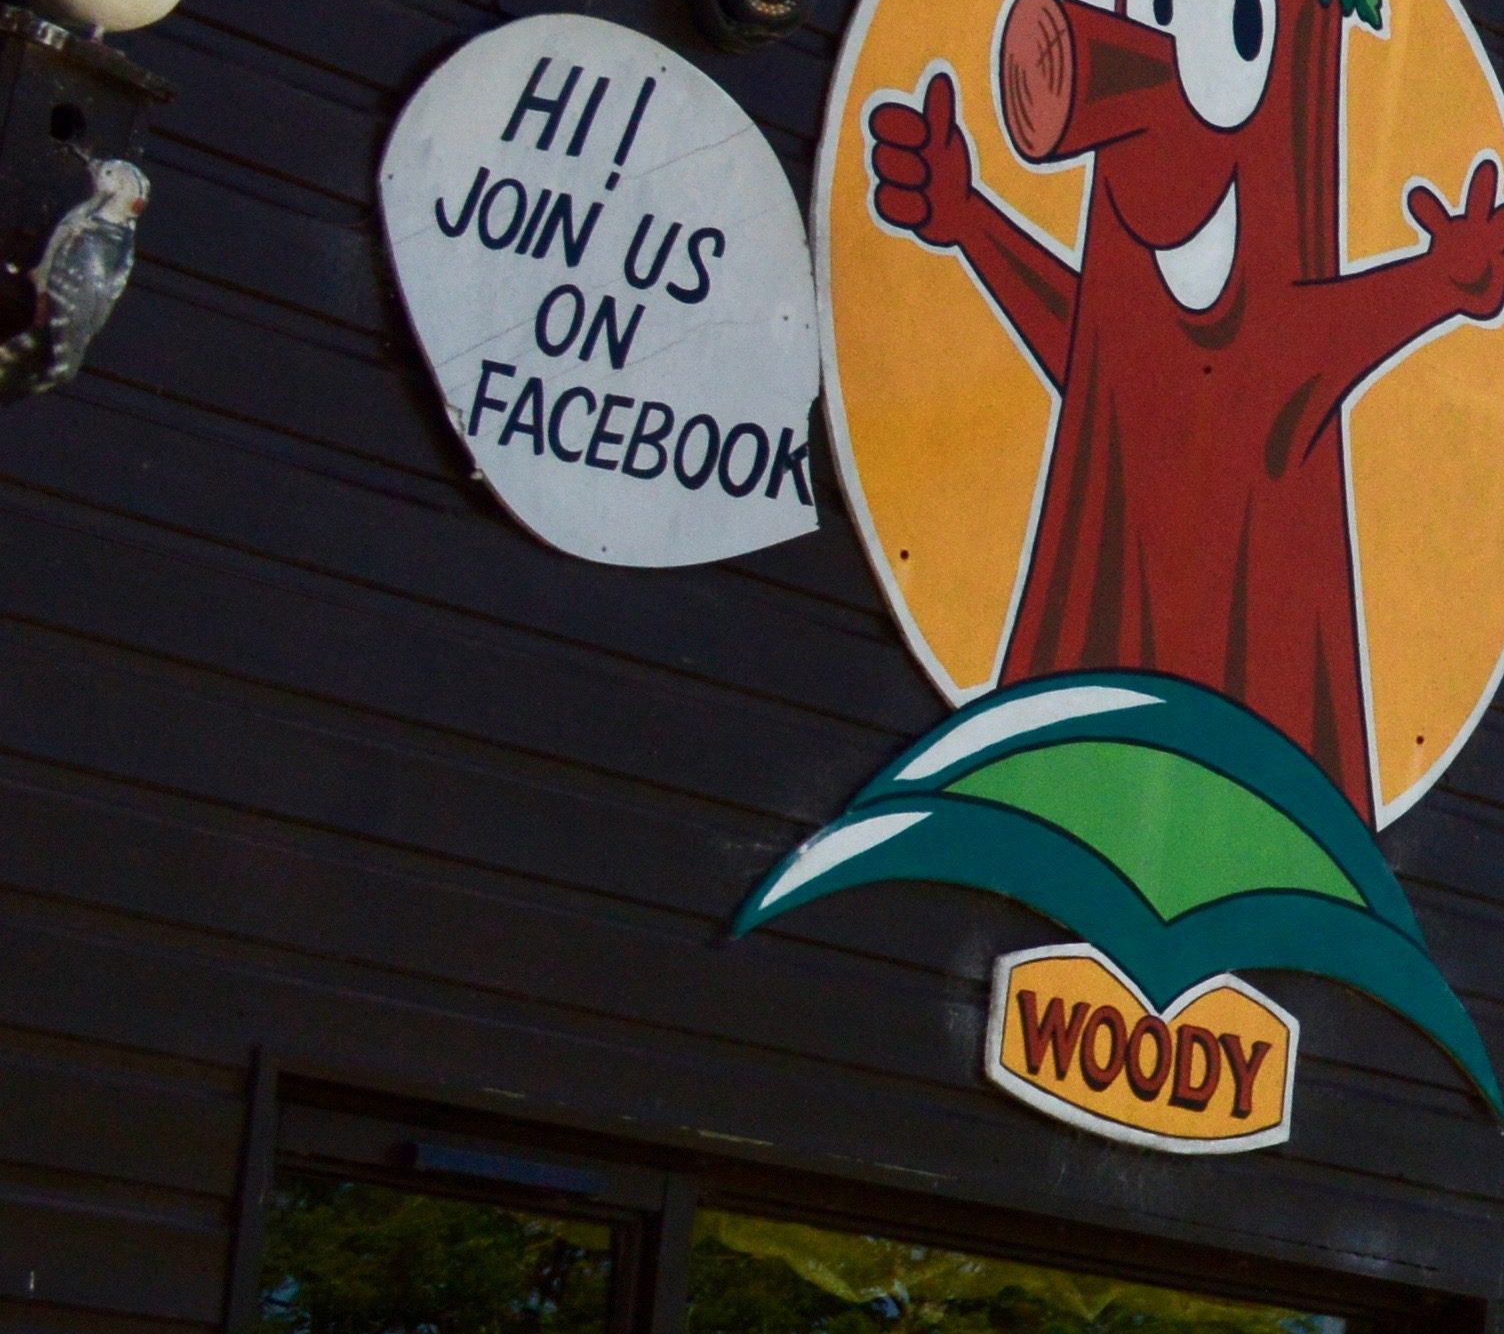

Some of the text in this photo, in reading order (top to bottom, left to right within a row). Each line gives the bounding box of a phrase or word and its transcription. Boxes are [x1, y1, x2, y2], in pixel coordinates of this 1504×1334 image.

[434, 166, 727, 305] JOIN US
[533, 283, 646, 371] ON
[467, 358, 816, 507] FACEBOOK
[1017, 989, 1273, 1119] WOODY
